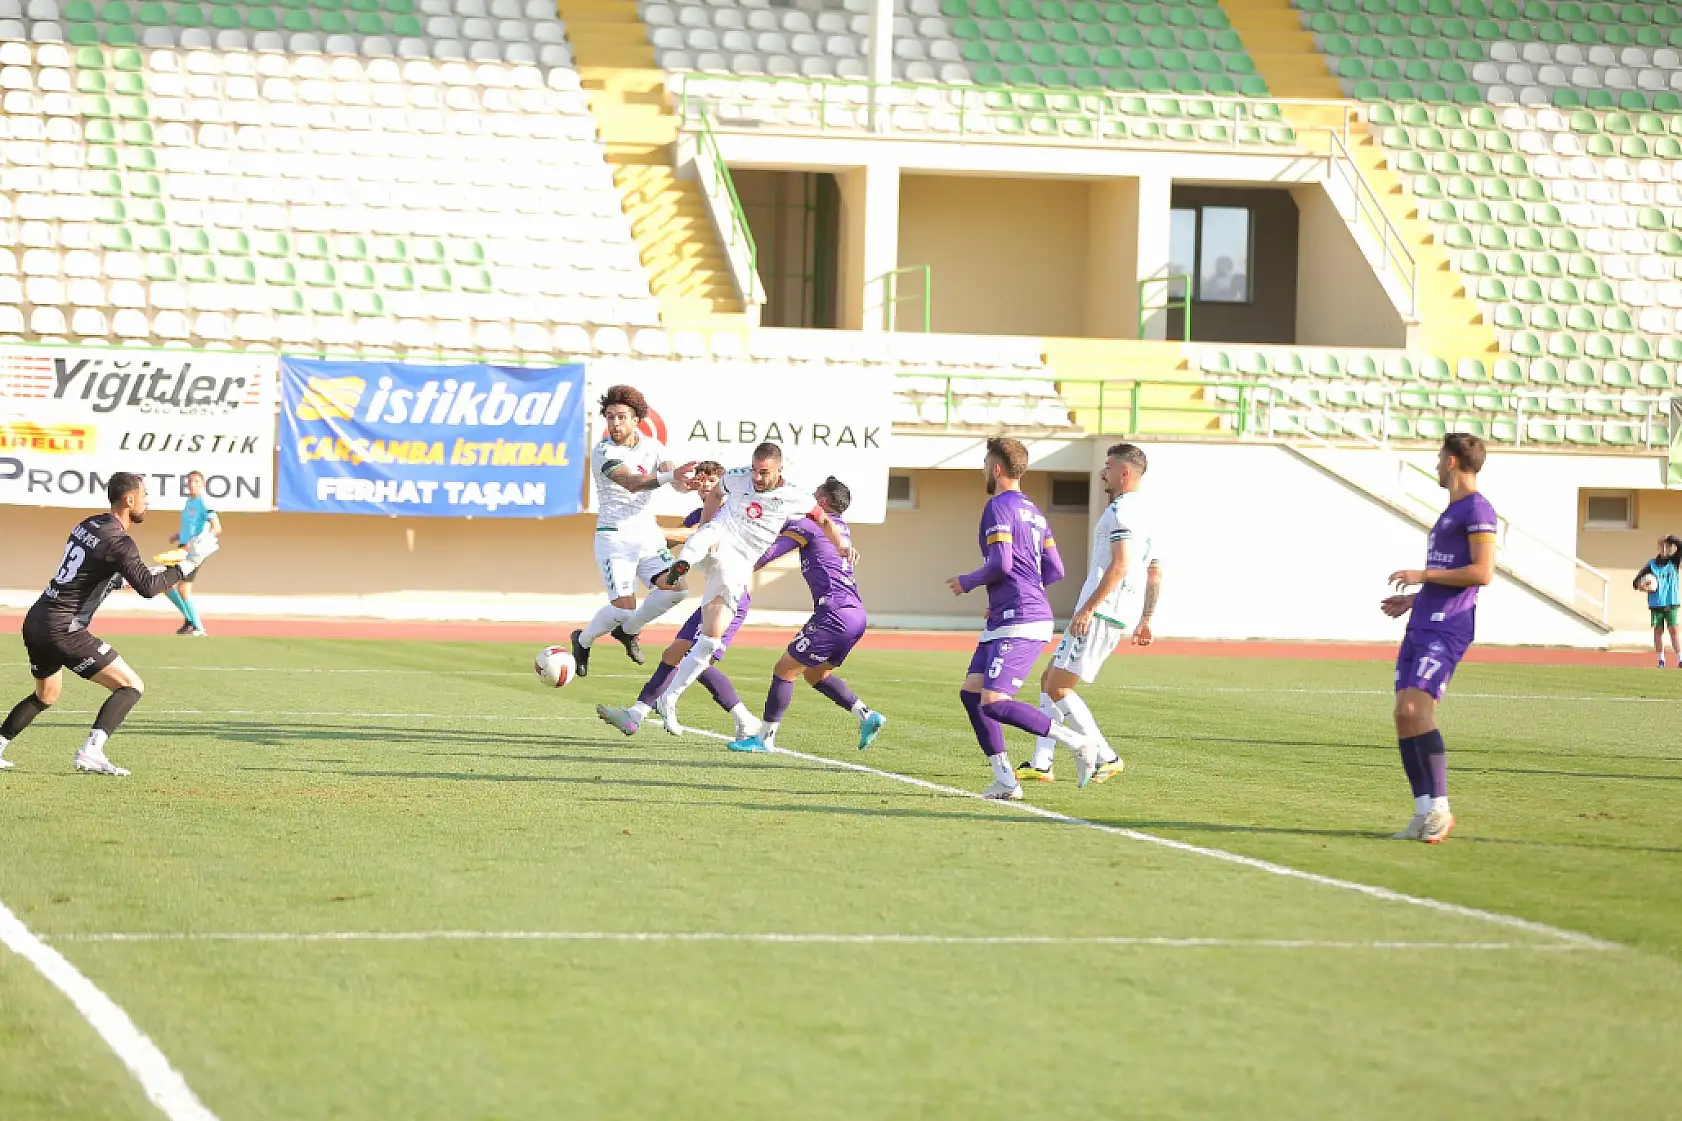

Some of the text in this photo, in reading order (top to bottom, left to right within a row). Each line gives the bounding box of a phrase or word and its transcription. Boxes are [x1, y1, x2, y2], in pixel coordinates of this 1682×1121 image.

[53, 357, 246, 413] Yiğitler
[365, 376, 572, 426] istikbal
[688, 419, 881, 449] ALBAYRAK
[298, 436, 569, 466] ÇARŞAMBA İSTİKBAL
[317, 477, 547, 511] FERHAT TAŞAN
[55, 540, 86, 585] 13
[988, 658, 1004, 679] 5
[1416, 656, 1443, 681] 17
